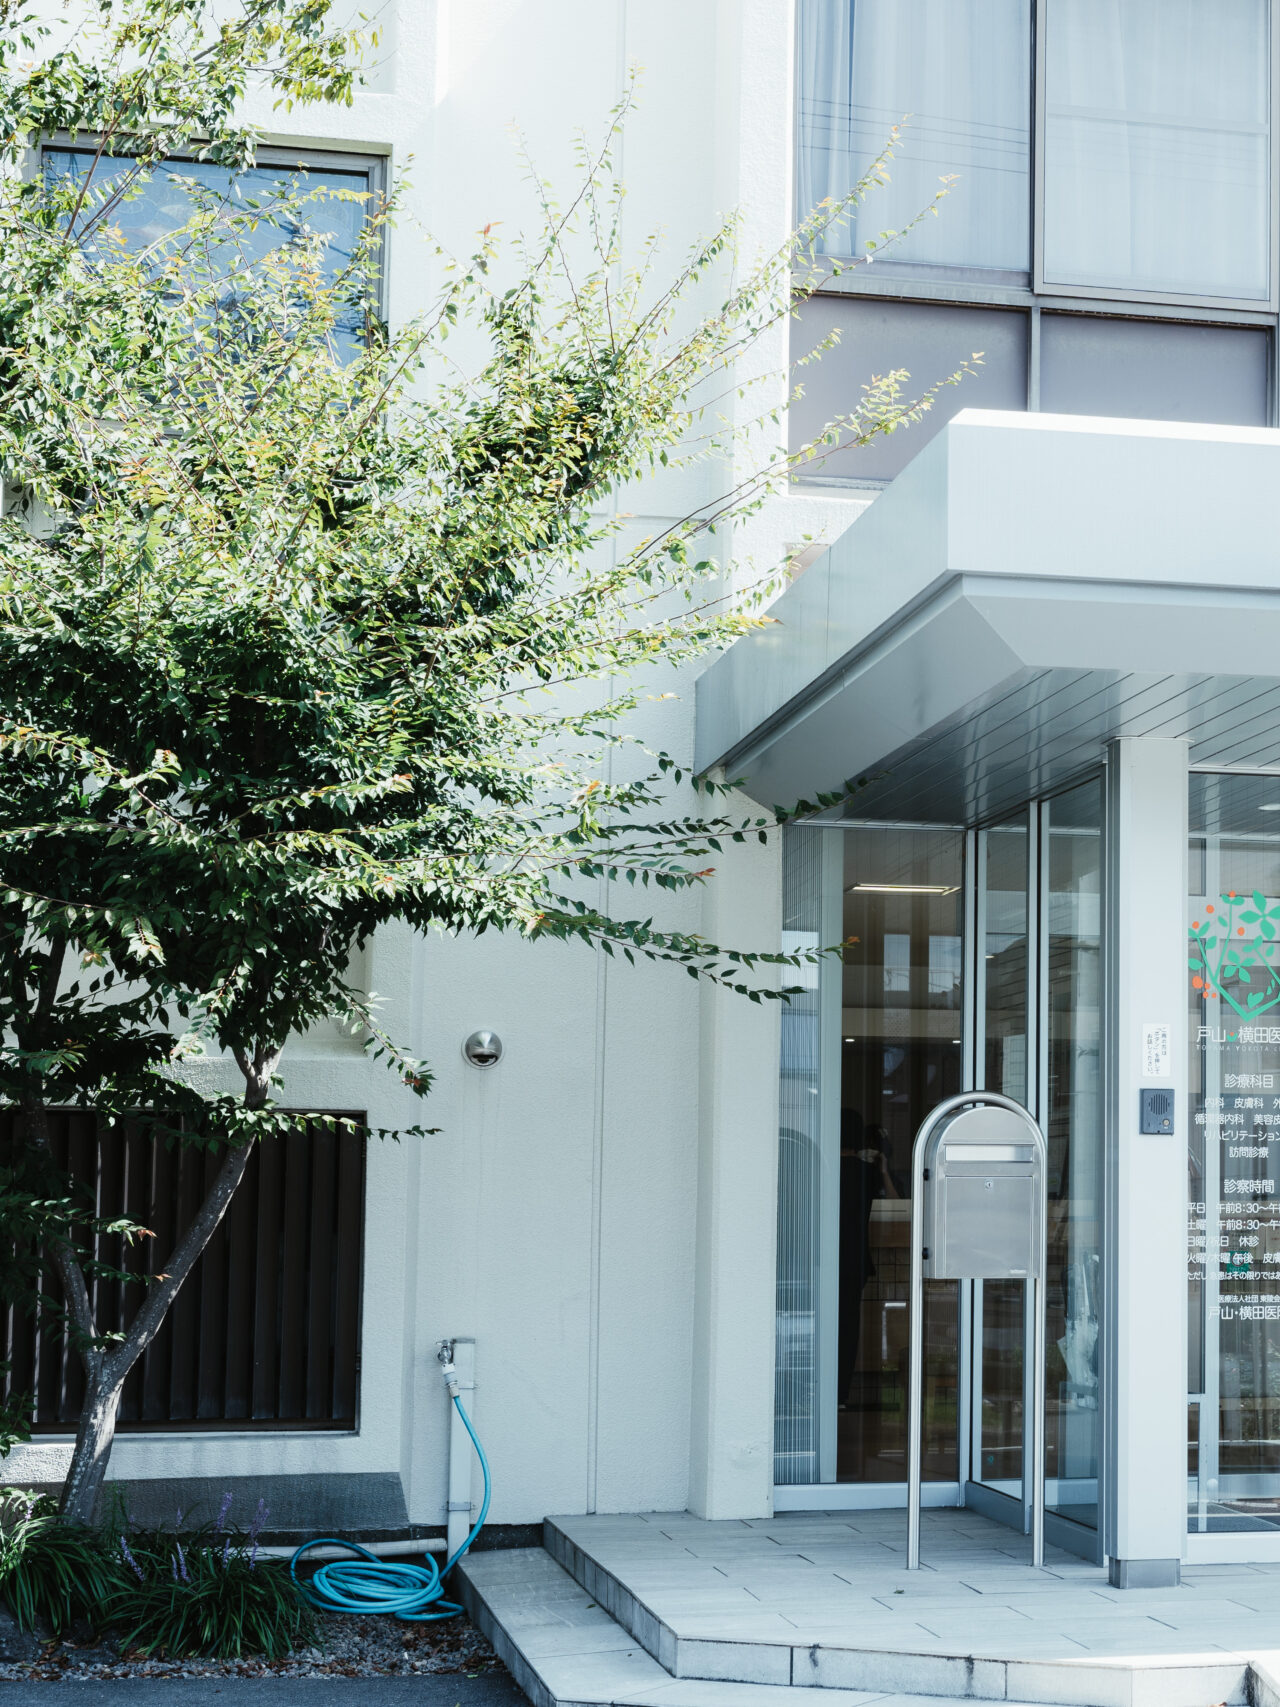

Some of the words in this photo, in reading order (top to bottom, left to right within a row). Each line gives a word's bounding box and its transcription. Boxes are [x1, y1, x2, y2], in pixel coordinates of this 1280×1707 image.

[1224, 1073, 1274, 1088] 診療科目
[1204, 1097, 1224, 1109] 内科
[1234, 1097, 1264, 1109] 皮膚科
[1229, 1146, 1269, 1158] 訪問診療
[1223, 1179, 1275, 1194] 診察時間
[1187, 1202, 1206, 1214] 平日
[1239, 1235, 1259, 1247] 休診
